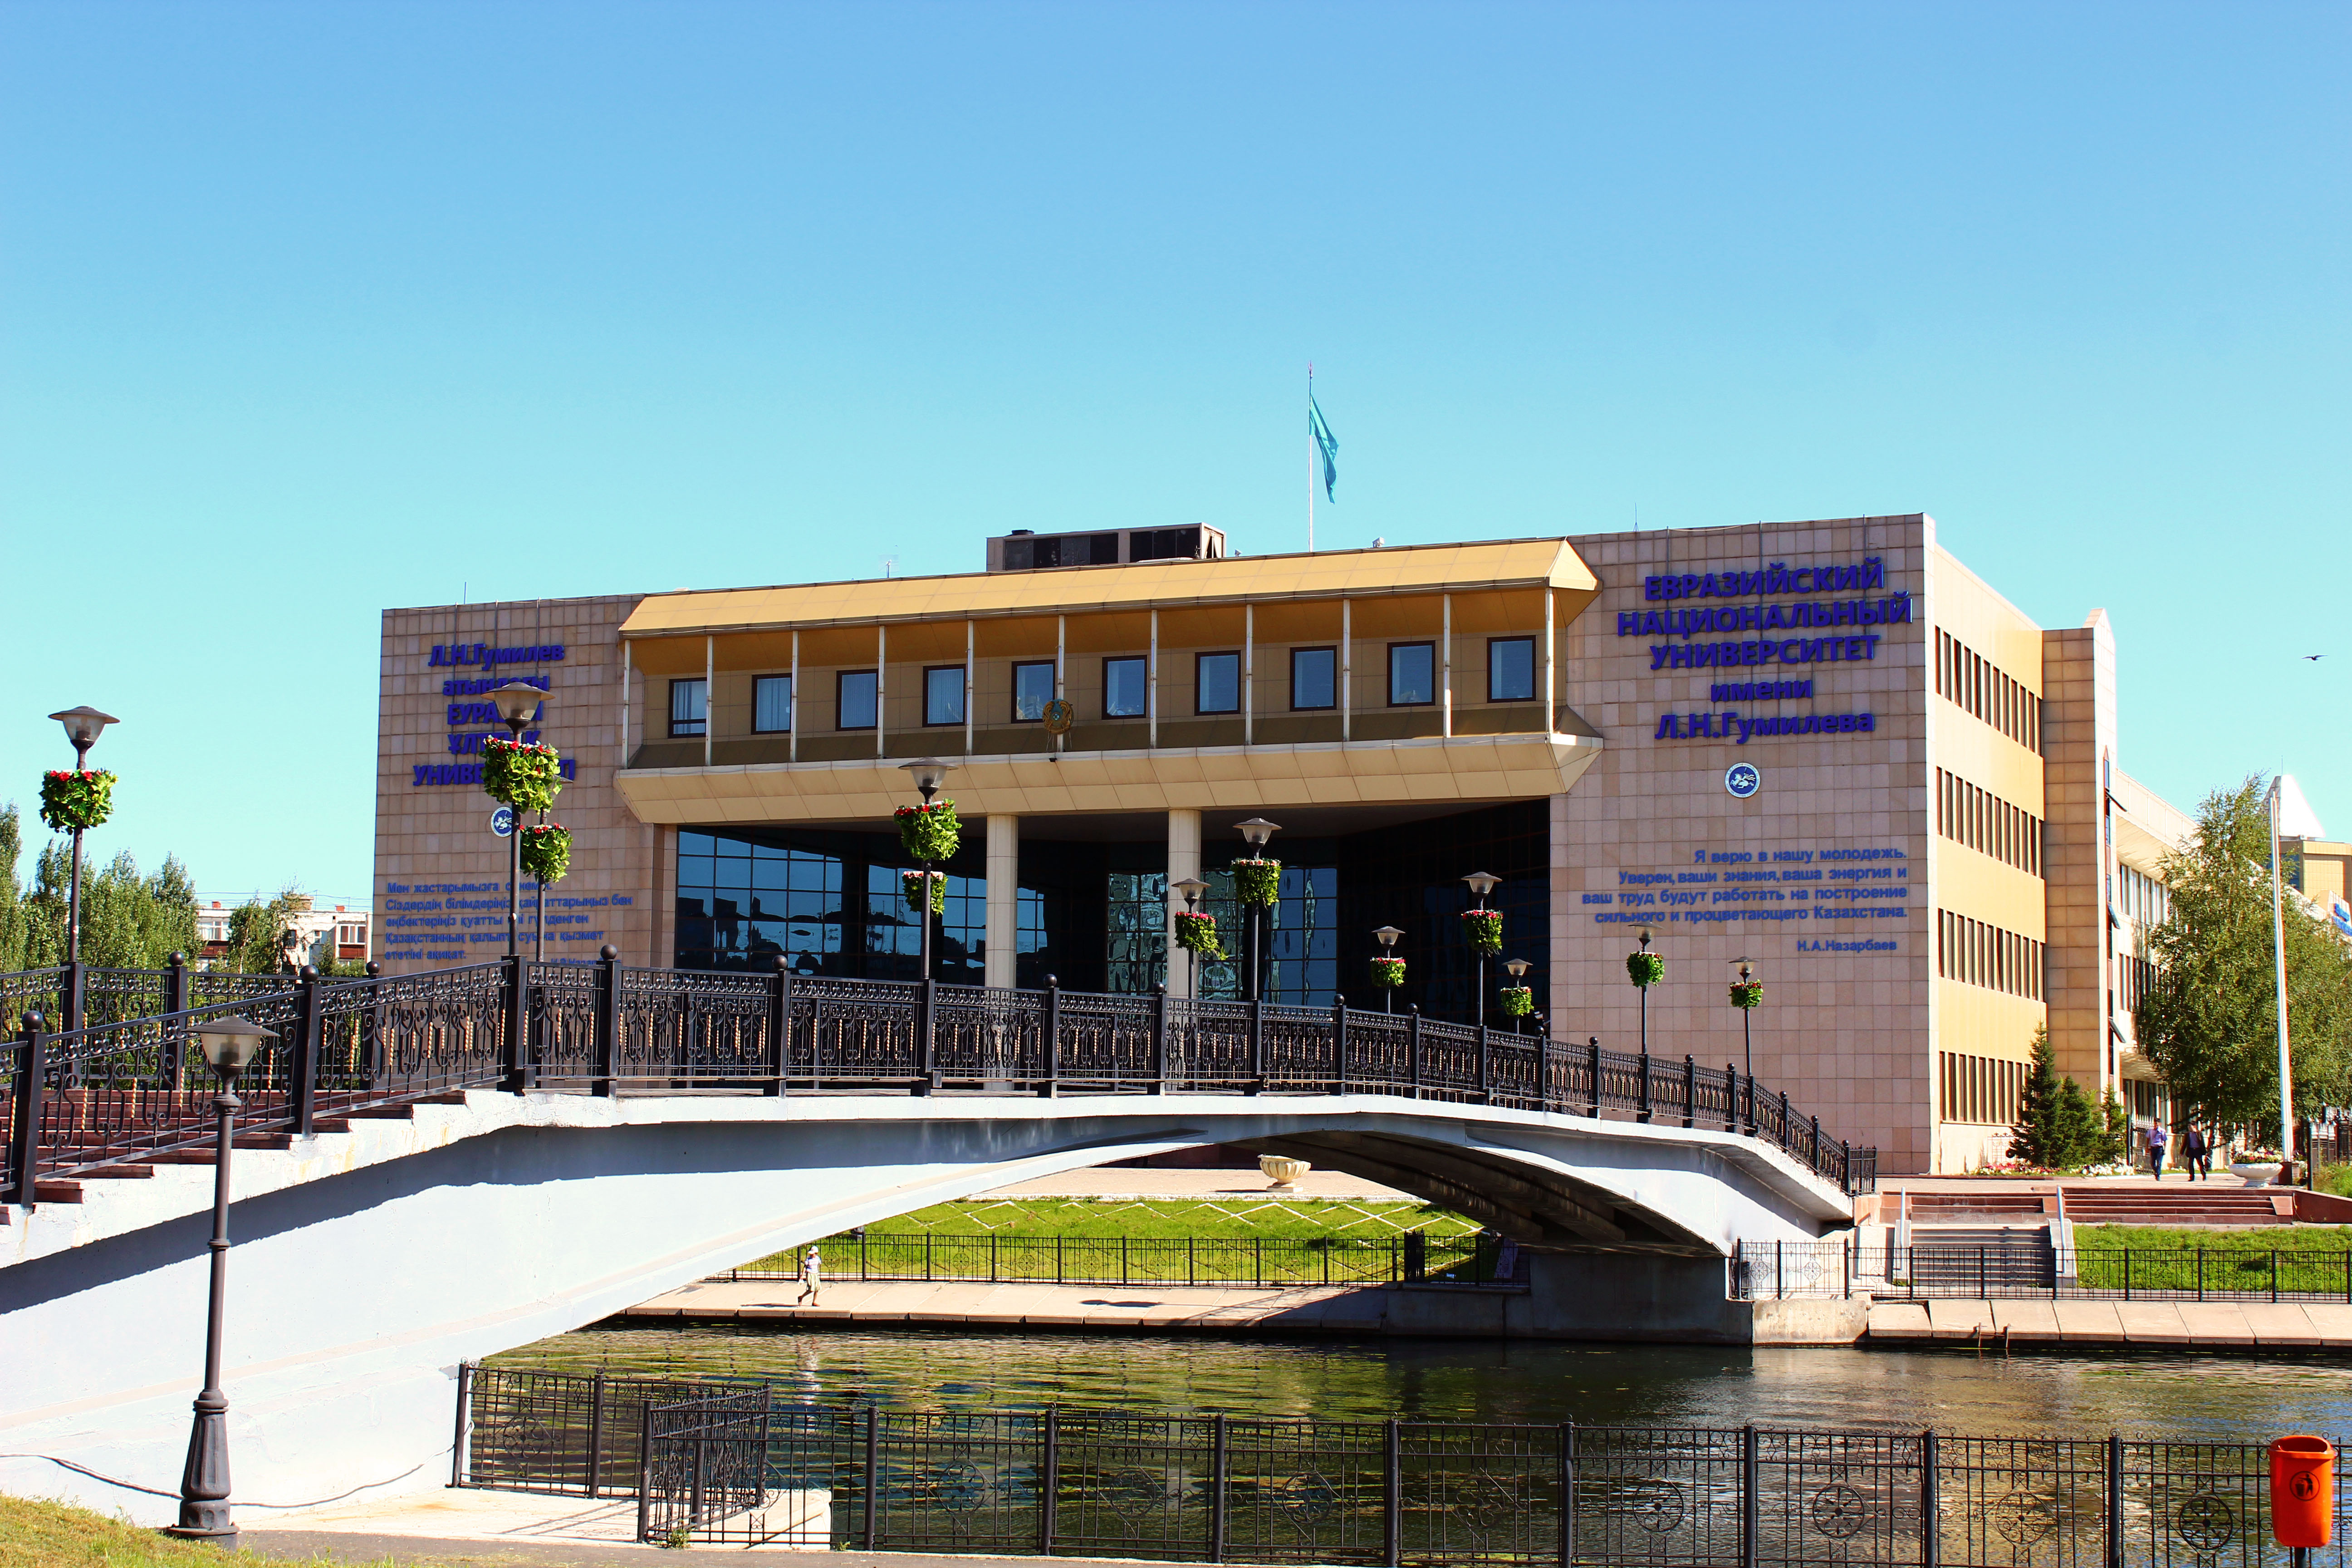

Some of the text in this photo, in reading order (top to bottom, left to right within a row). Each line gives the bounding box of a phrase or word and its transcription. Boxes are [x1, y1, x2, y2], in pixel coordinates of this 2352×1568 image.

[1645, 555, 1886, 602] ЕВРАЗИЙСКИЙ
[1617, 589, 1913, 641] НАЦИОНАЛЬНЫЙ
[428, 643, 565, 671] Л.Н.Гумилев
[1650, 633, 1881, 670] УНИВЕРСИТЕТ
[1710, 678, 1813, 702] имени
[1655, 710, 1876, 744] Л.Н.Гумилева
[1695, 848, 1907, 865] Я верю в нашу молодежь.
[1619, 868, 1907, 886] Уверен, ваши знания, ваша энергия и
[387, 882, 410, 893] Мен
[1582, 887, 1907, 906] ваш труд будут работать на построение
[386, 899, 442, 911] Сіздердің
[612, 894, 632, 905] бен
[386, 915, 456, 928] еңбектеріңіз
[461, 916, 503, 928] қуатты
[1595, 906, 1907, 924] сильного и процветающего Казахстана.
[386, 933, 466, 945] Қазақстанның
[560, 931, 604, 941] қызмет
[1797, 940, 1897, 953] Н.А.Назарбаев
[385, 949, 466, 960] ететіні ақиқат.
